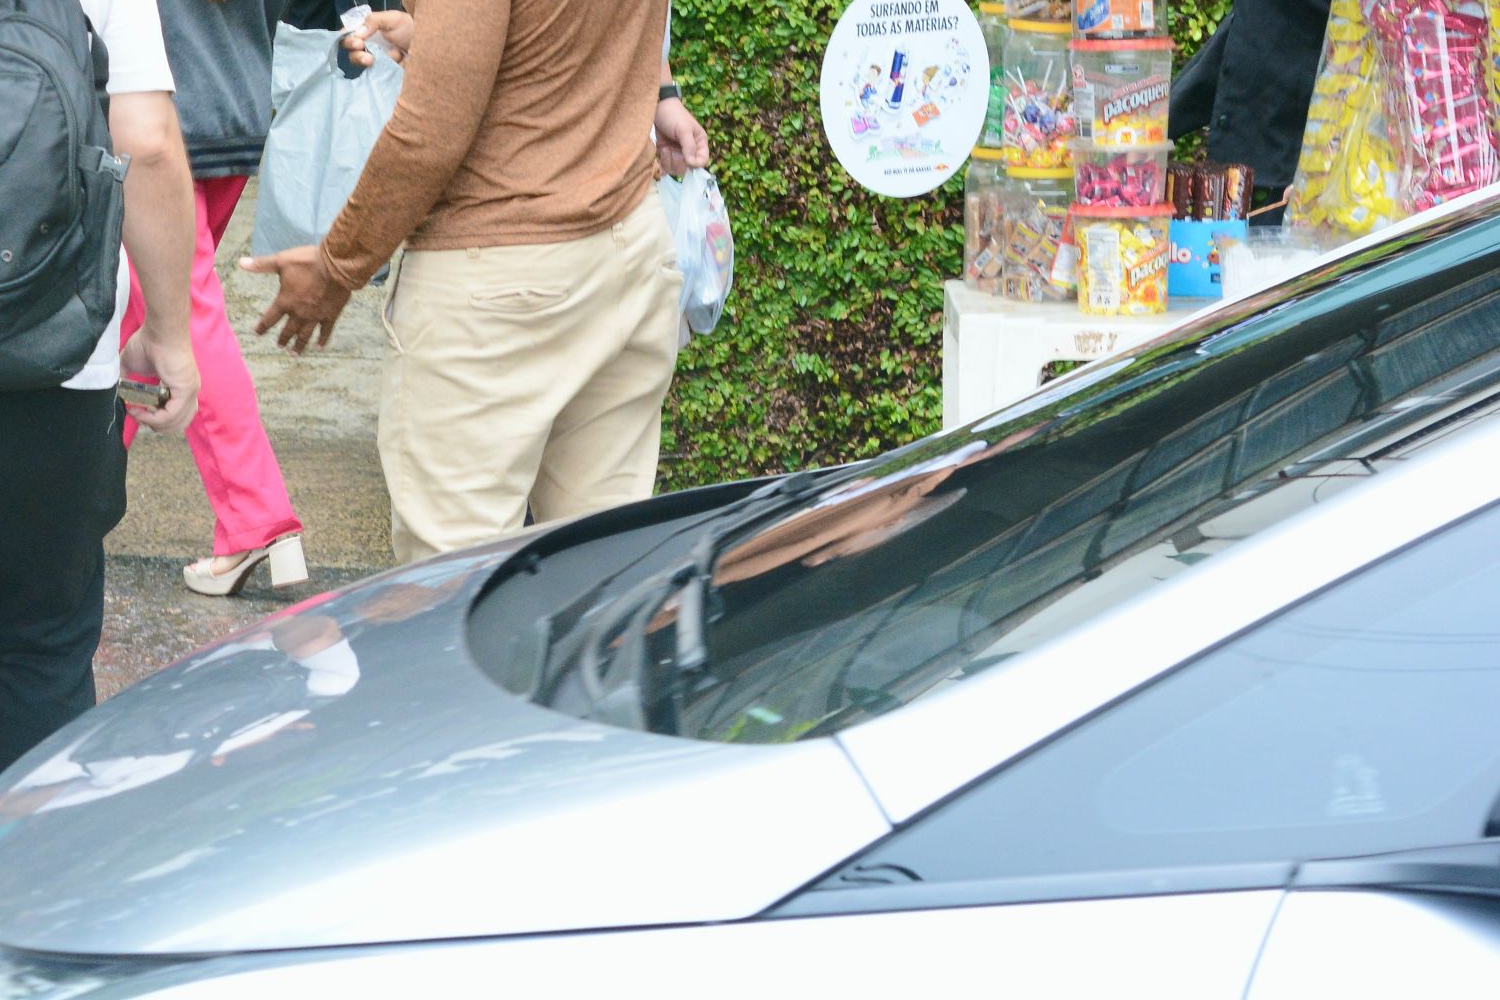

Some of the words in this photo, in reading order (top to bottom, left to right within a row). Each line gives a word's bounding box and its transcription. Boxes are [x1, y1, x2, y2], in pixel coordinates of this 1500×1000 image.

[870, 1, 922, 18] SURFANDO
[924, 0, 939, 15] EM
[856, 21, 887, 37] TODAS
[889, 19, 902, 34] AS
[904, 13, 959, 34] MATÉRIAS?
